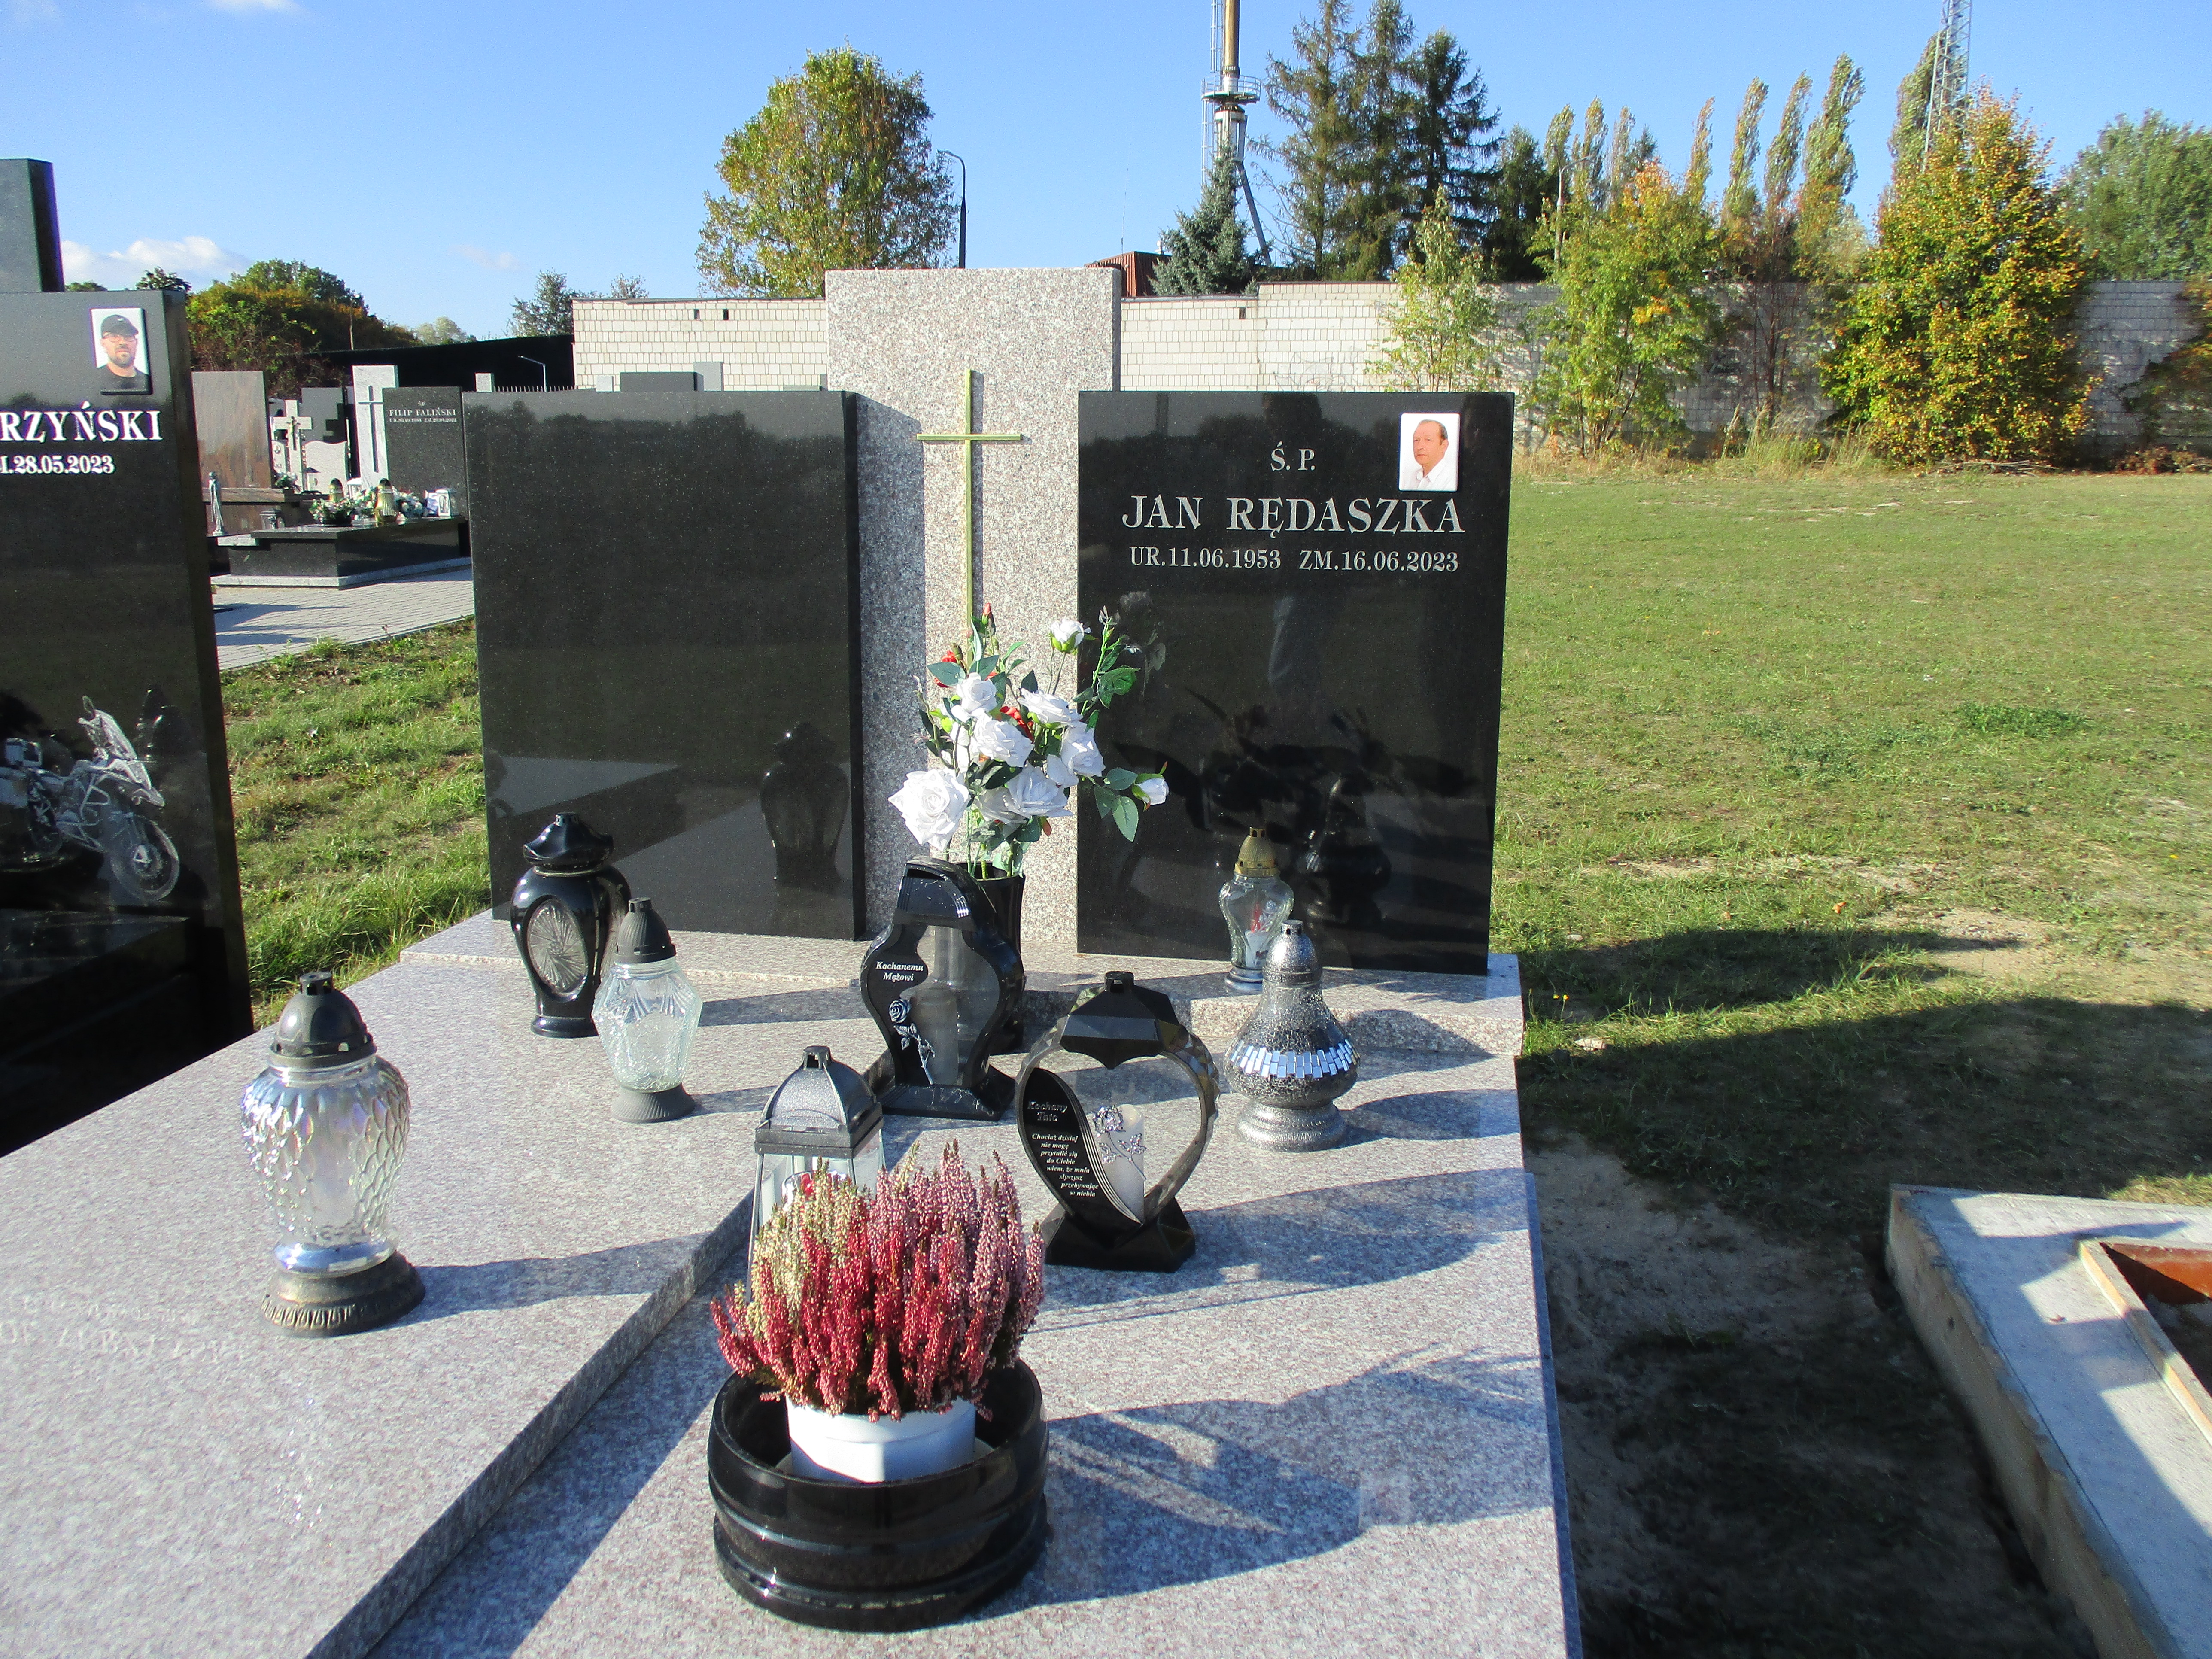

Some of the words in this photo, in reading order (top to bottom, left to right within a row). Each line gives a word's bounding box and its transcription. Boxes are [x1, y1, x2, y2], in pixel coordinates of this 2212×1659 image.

[416, 407, 456, 416] FALIŃSKI
[0, 401, 164, 443] RZYŃSKI
[1121, 495, 1204, 530] JAN
[1226, 496, 1465, 539] RĘDASZKA
[1129, 546, 1282, 570] UR.11.06.1953
[1299, 549, 1459, 572] ZM.16.06.2023
[875, 961, 924, 972] Kochanemu
[883, 972, 915, 982] Mężowi
[1027, 1101, 1068, 1113] Kochany
[1037, 1112, 1058, 1121] Tato
[1058, 1135, 1078, 1143] dzisiaj
[1060, 1182, 1099, 1190] przebywając
